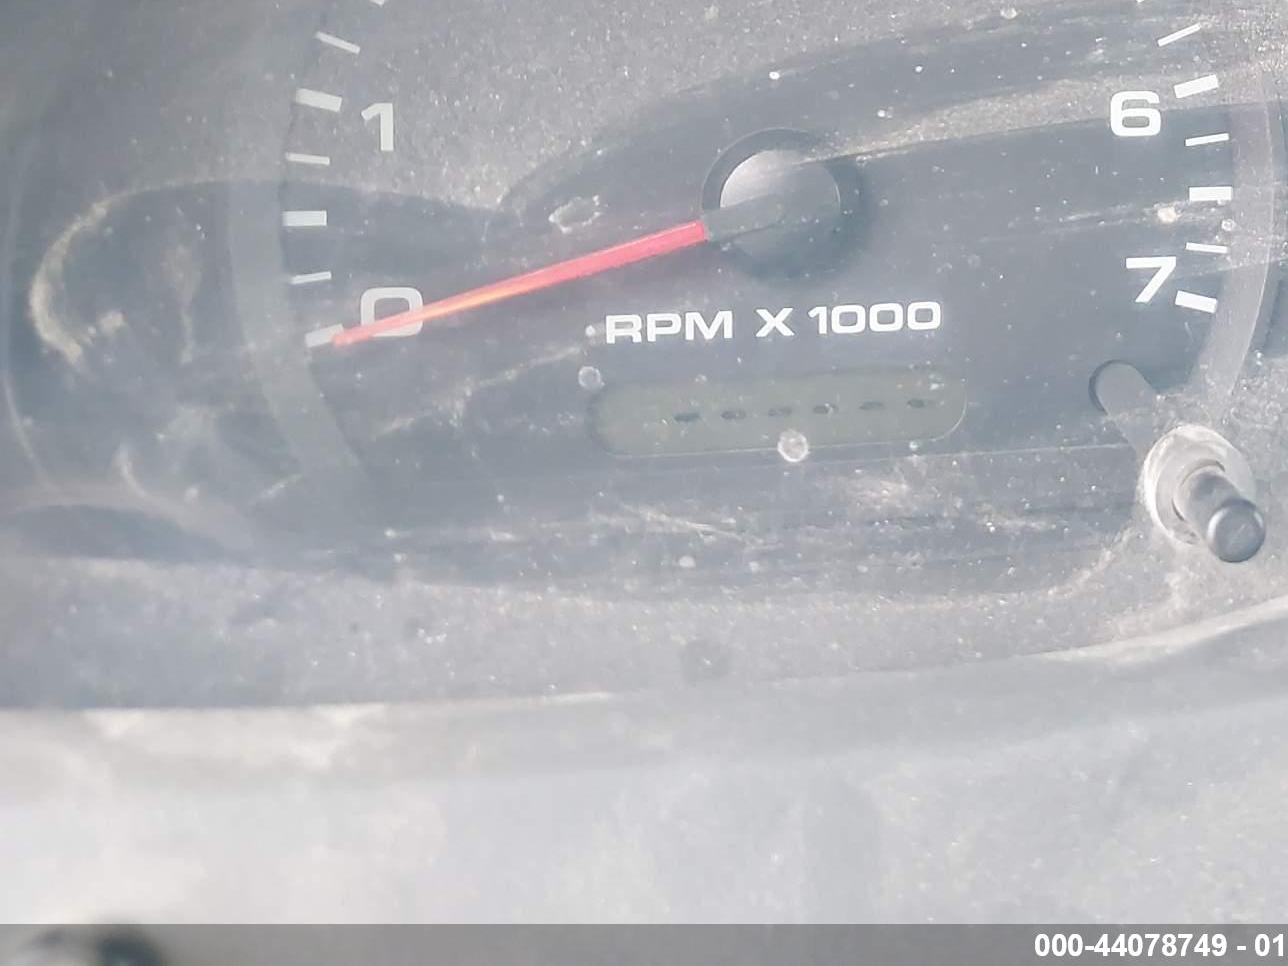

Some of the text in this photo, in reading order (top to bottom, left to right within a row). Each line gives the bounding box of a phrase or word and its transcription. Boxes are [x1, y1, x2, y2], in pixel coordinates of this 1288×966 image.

[361, 102, 395, 152] 1
[1110, 90, 1162, 137] 6
[1125, 256, 1177, 304] 7
[360, 286, 424, 337] 0
[605, 301, 942, 344] RPM X 1000
